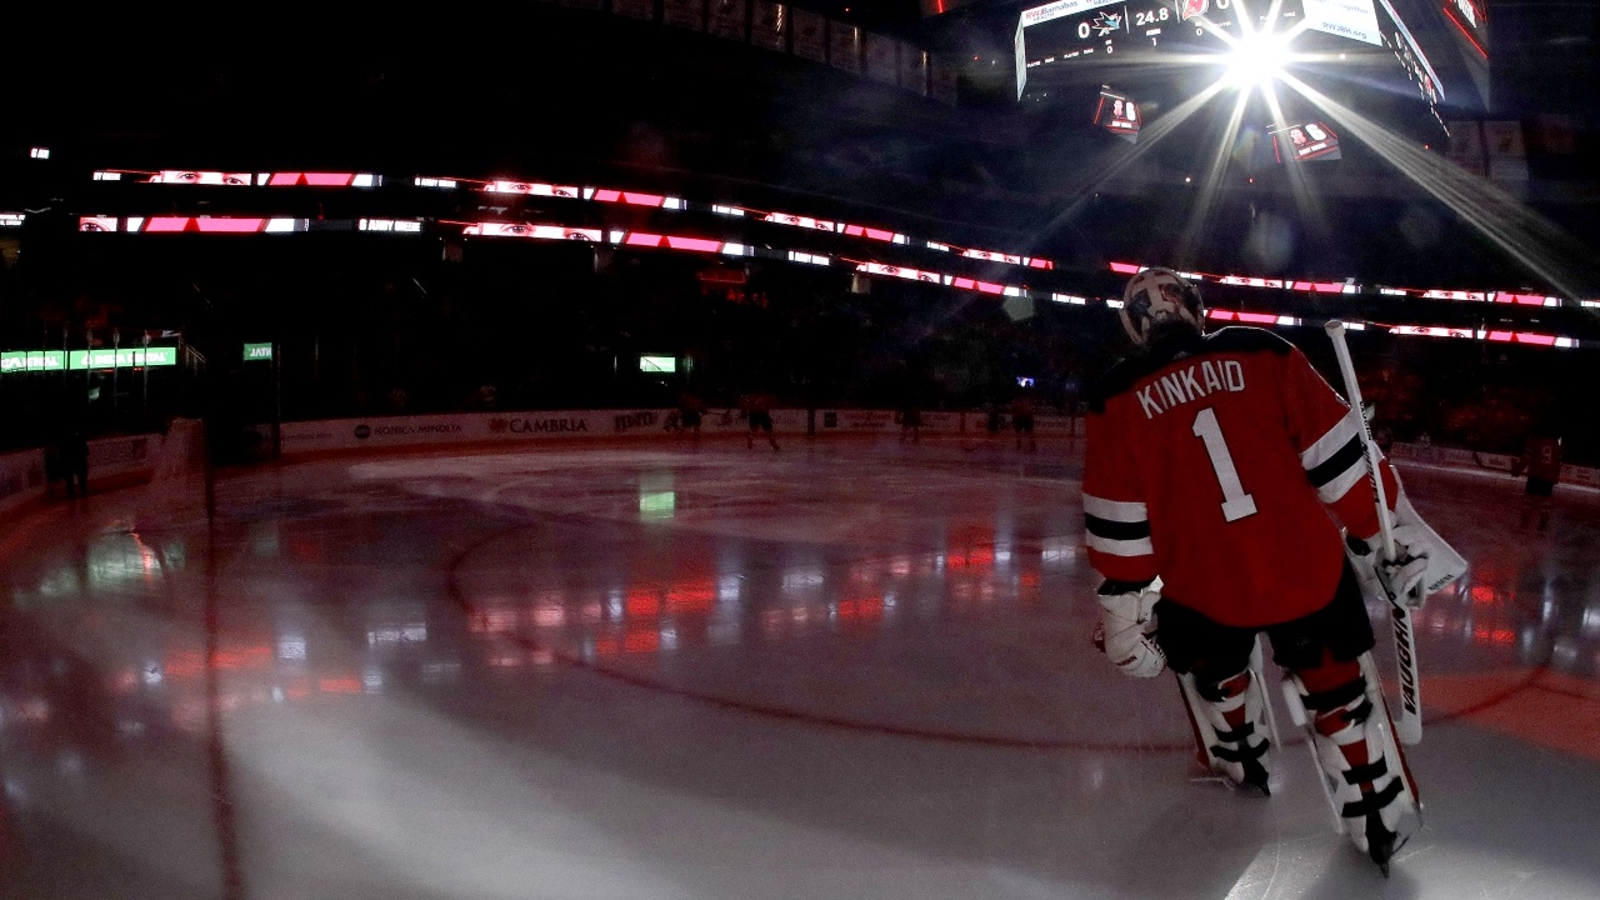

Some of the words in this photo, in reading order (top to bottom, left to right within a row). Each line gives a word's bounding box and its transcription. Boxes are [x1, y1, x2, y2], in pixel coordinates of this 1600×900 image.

[1135, 7, 1169, 26] 24.8
[1078, 22, 1090, 39] 0
[1195, 28, 1203, 36] 0
[1106, 45, 1113, 54] 0
[1151, 37, 1157, 47] 1
[1136, 360, 1246, 420] KINKAID
[374, 425, 415, 435] KONICA
[417, 423, 462, 434] MINOLTA
[509, 418, 588, 433] CAMBRIA
[1191, 407, 1258, 523] 1
[1391, 603, 1417, 716] VAUGHN
